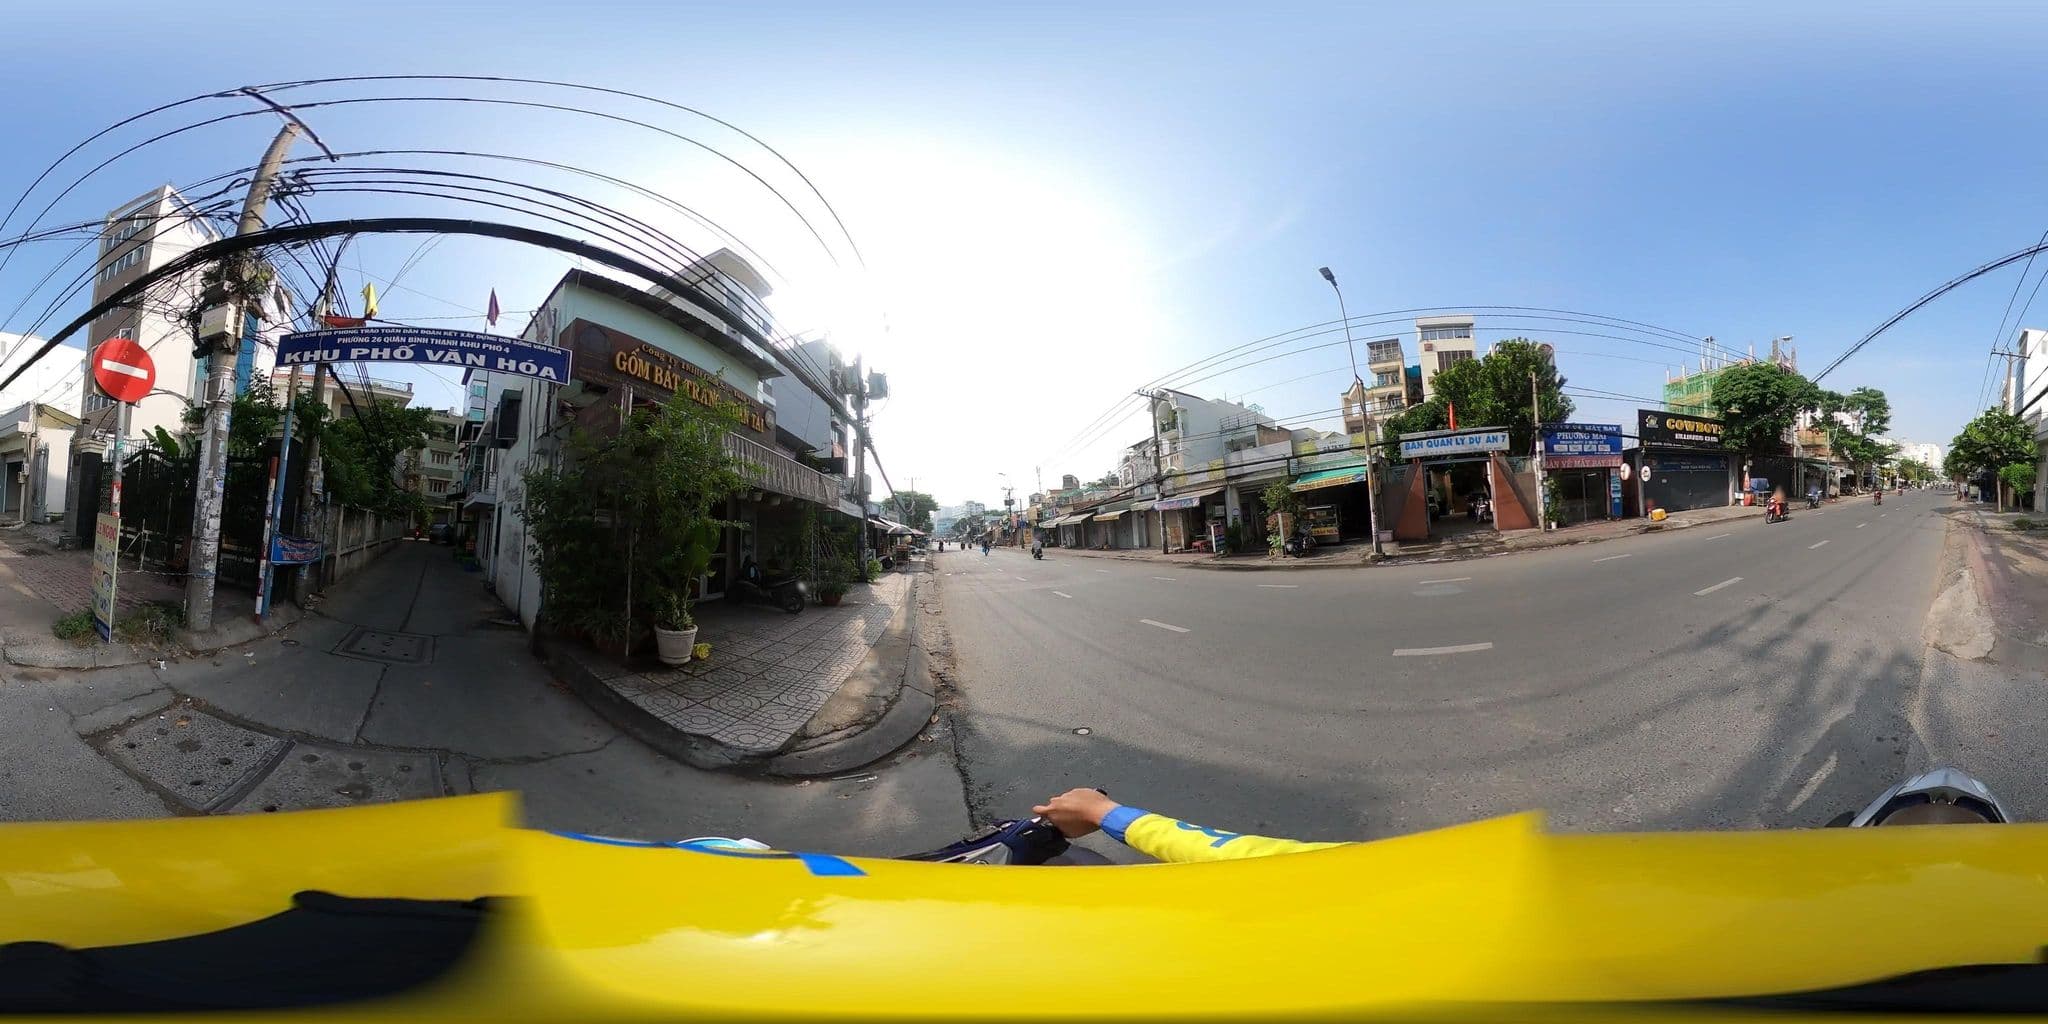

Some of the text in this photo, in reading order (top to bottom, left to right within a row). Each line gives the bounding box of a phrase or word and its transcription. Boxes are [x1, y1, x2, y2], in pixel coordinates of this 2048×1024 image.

[459, 341, 480, 349] KHU
[284, 348, 340, 364] KHU
[350, 343, 416, 362] PHỐ
[425, 348, 486, 367] VĂN
[497, 356, 558, 380] HÓA
[615, 347, 650, 381] GỐM
[1502, 434, 1507, 442] 7
